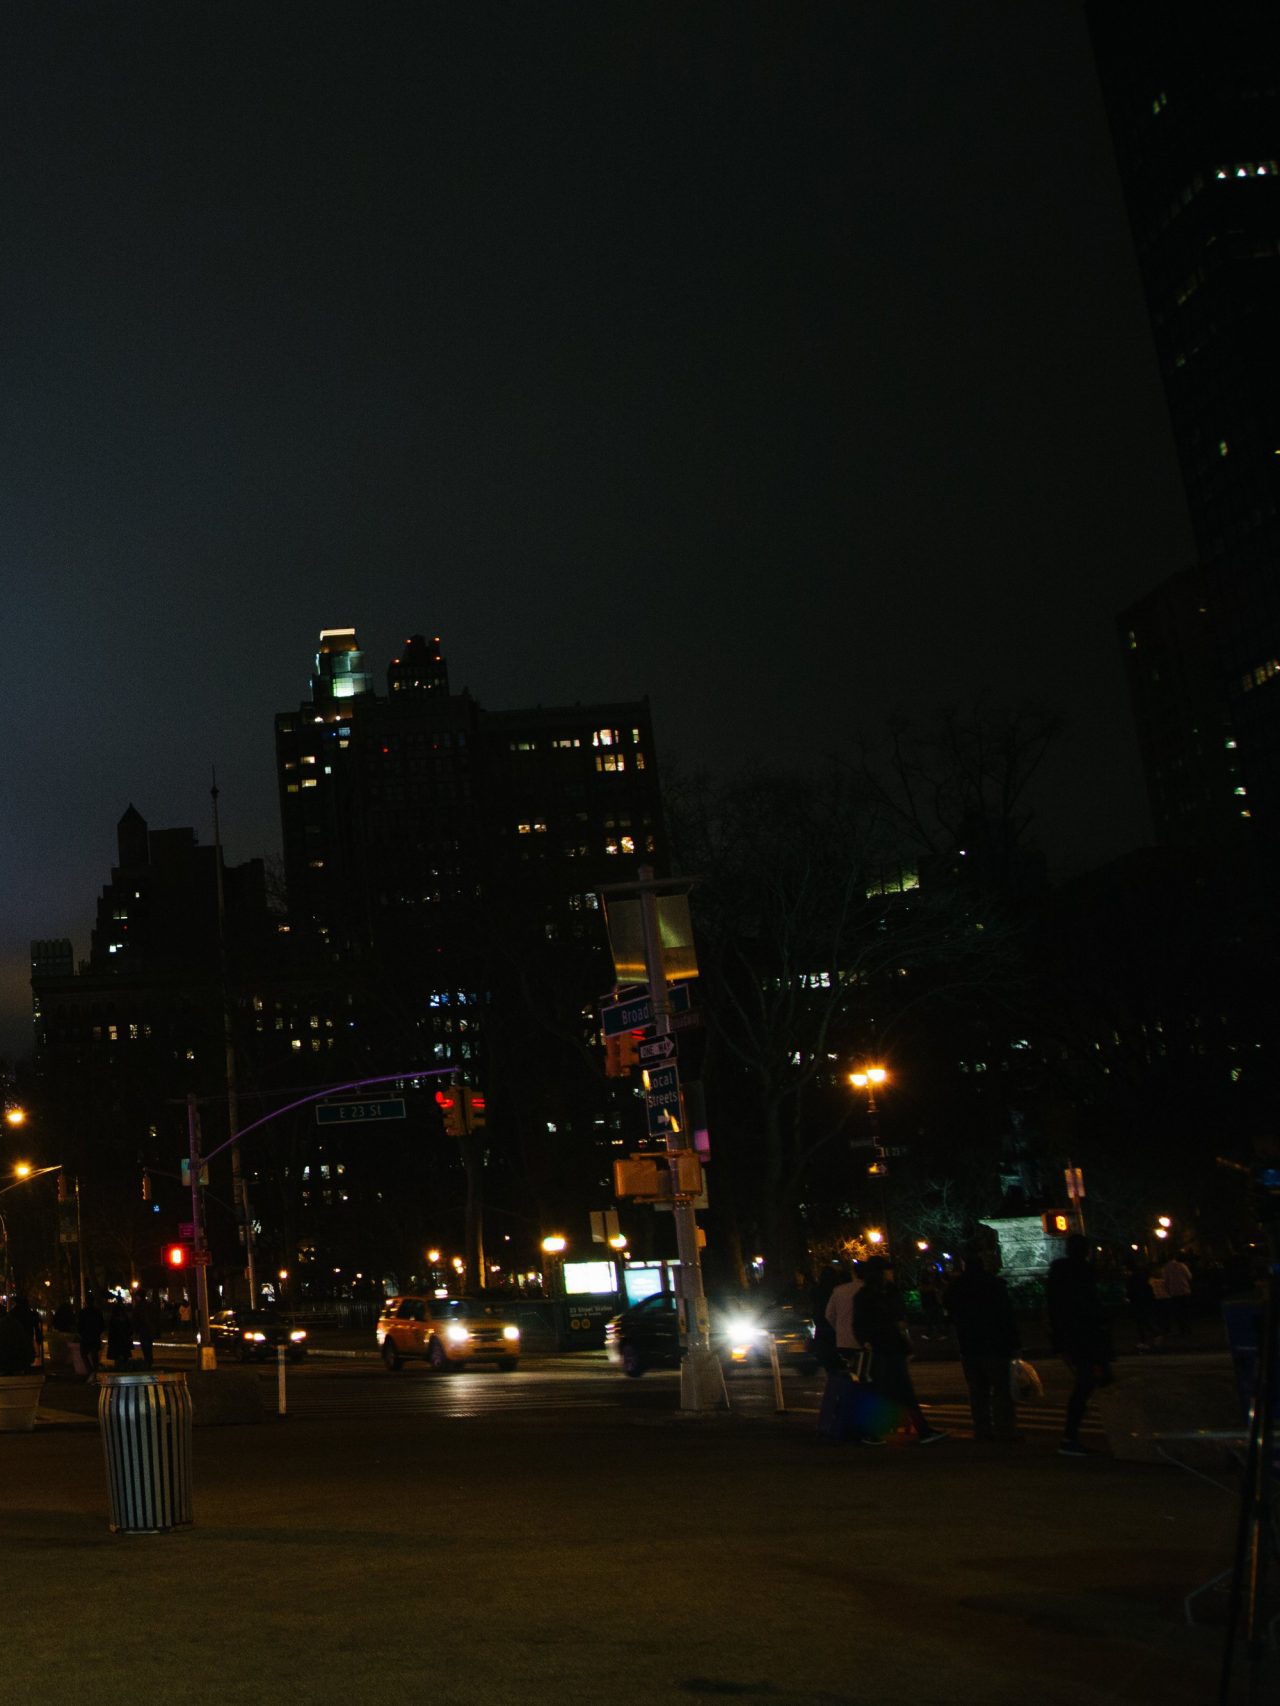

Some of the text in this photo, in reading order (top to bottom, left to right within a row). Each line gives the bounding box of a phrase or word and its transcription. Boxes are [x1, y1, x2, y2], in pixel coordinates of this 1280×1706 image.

[642, 1041, 672, 1057] ONE WAY
[650, 1071, 673, 1090] ocal
[648, 1090, 678, 1108] Streets
[340, 1104, 382, 1118] E 23 St
